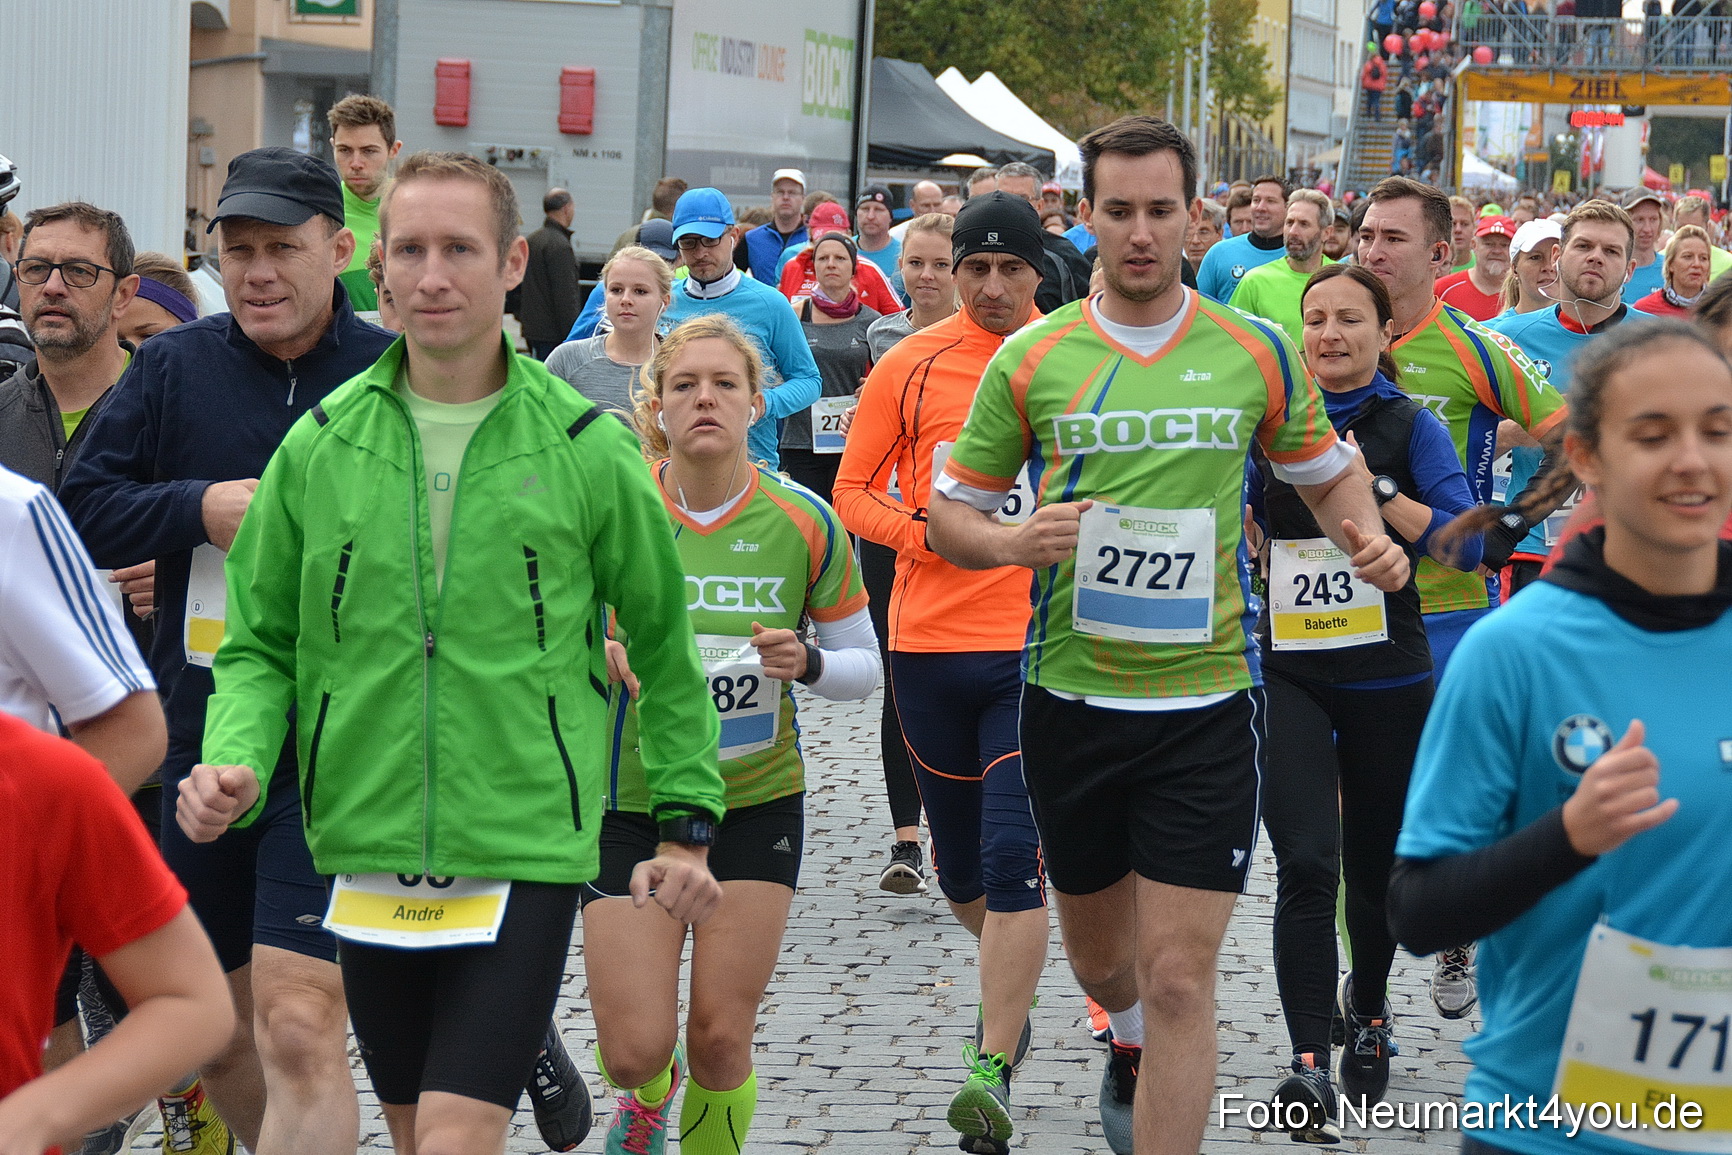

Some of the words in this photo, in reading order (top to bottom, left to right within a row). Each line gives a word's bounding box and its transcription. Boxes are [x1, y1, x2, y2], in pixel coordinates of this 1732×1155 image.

[1569, 78, 1628, 100] ZIEL
[1053, 407, 1243, 455] BOCK
[1132, 519, 1179, 534] BOCK
[1096, 545, 1196, 590] 2727
[1293, 570, 1353, 606] 243
[1304, 617, 1348, 630] Babette
[392, 905, 444, 921] André
